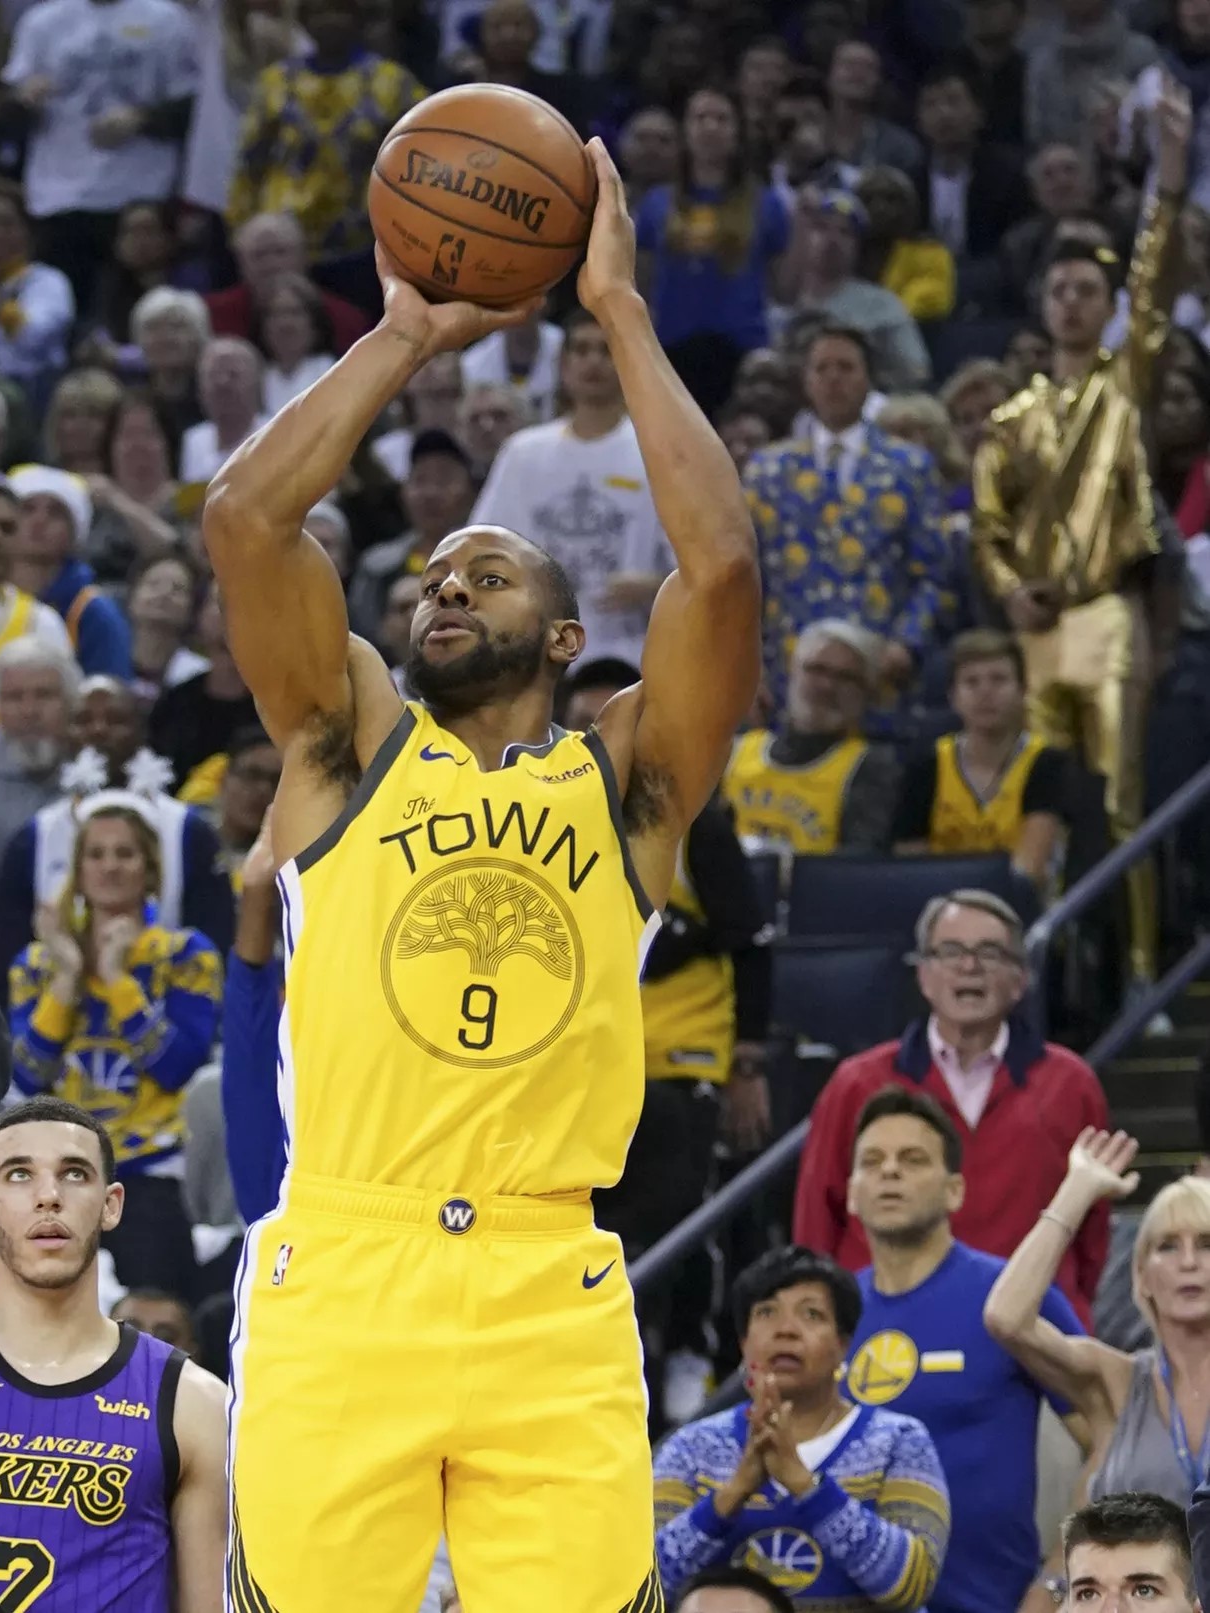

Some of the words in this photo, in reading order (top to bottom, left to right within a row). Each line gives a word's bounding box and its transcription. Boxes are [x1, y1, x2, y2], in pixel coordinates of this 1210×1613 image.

[399, 150, 550, 234] SPALDING
[541, 761, 595, 782] kuten
[402, 796, 436, 820] The
[379, 798, 600, 893] TOWN
[458, 983, 498, 1050] 9
[445, 1206, 473, 1227] W
[94, 1394, 151, 1420] wish
[23, 1435, 138, 1463] ANGELES
